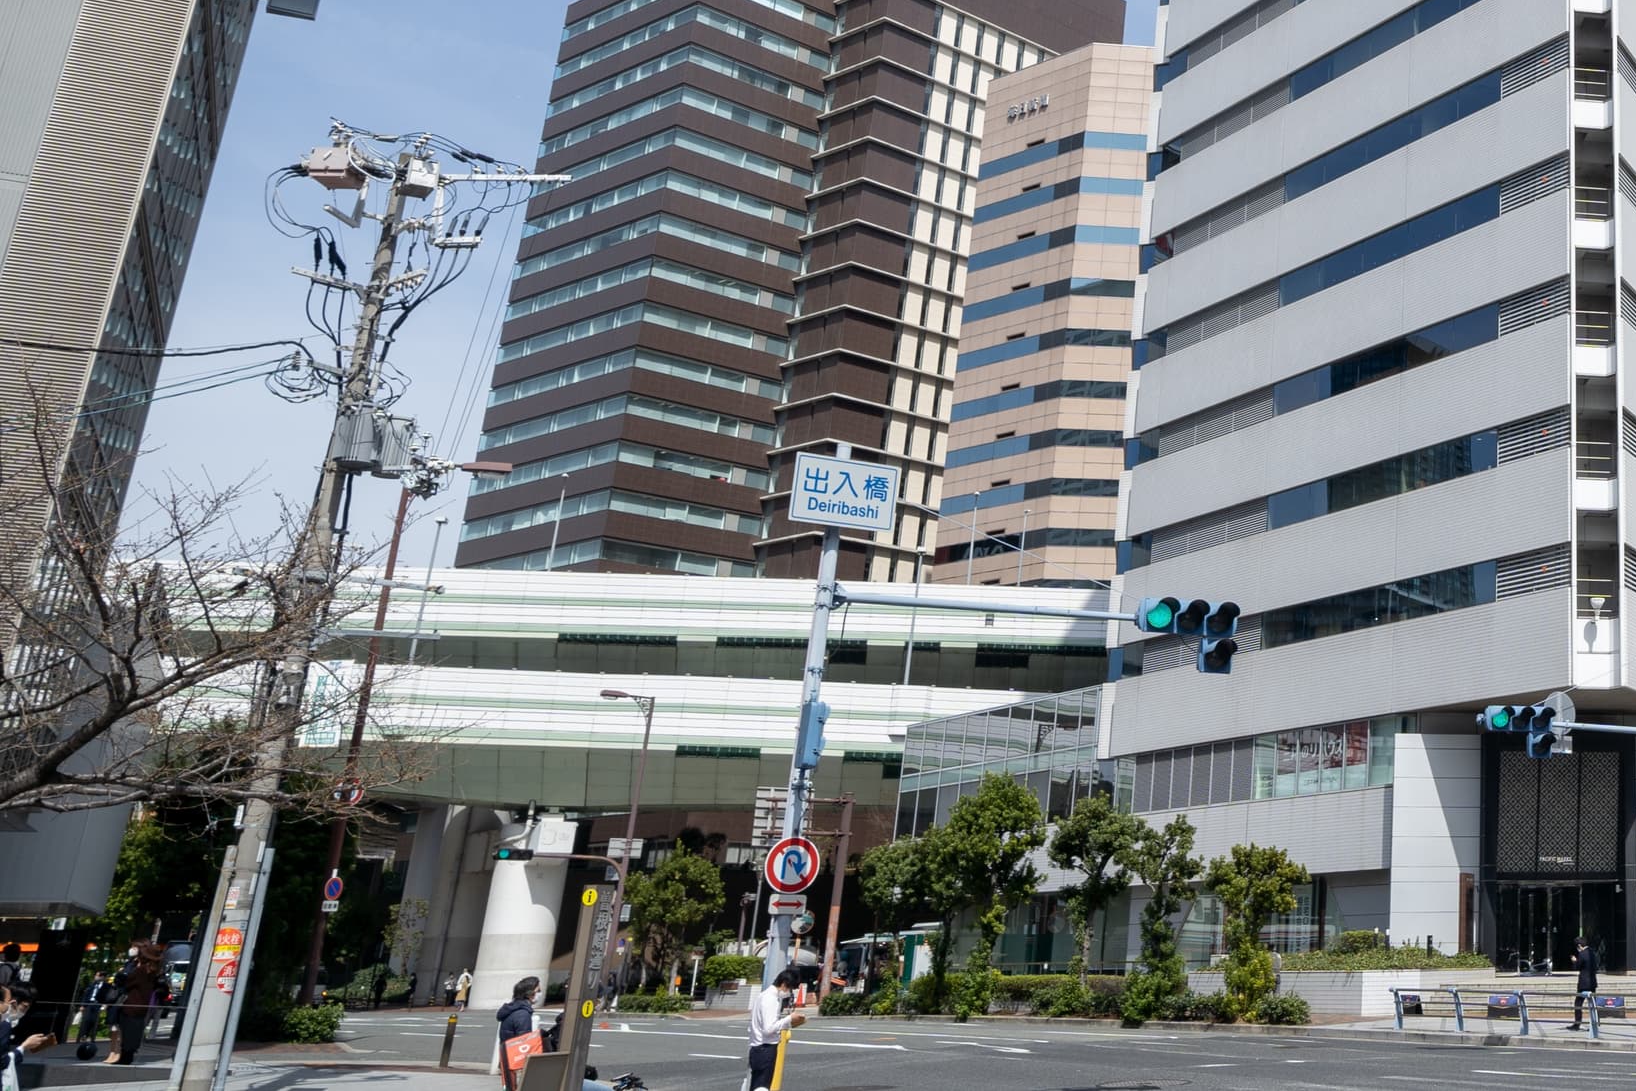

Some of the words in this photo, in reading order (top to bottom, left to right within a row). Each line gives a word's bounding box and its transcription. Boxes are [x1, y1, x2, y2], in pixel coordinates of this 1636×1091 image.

[803, 467, 889, 503] 出入橋
[807, 497, 879, 519] Deiribashi
